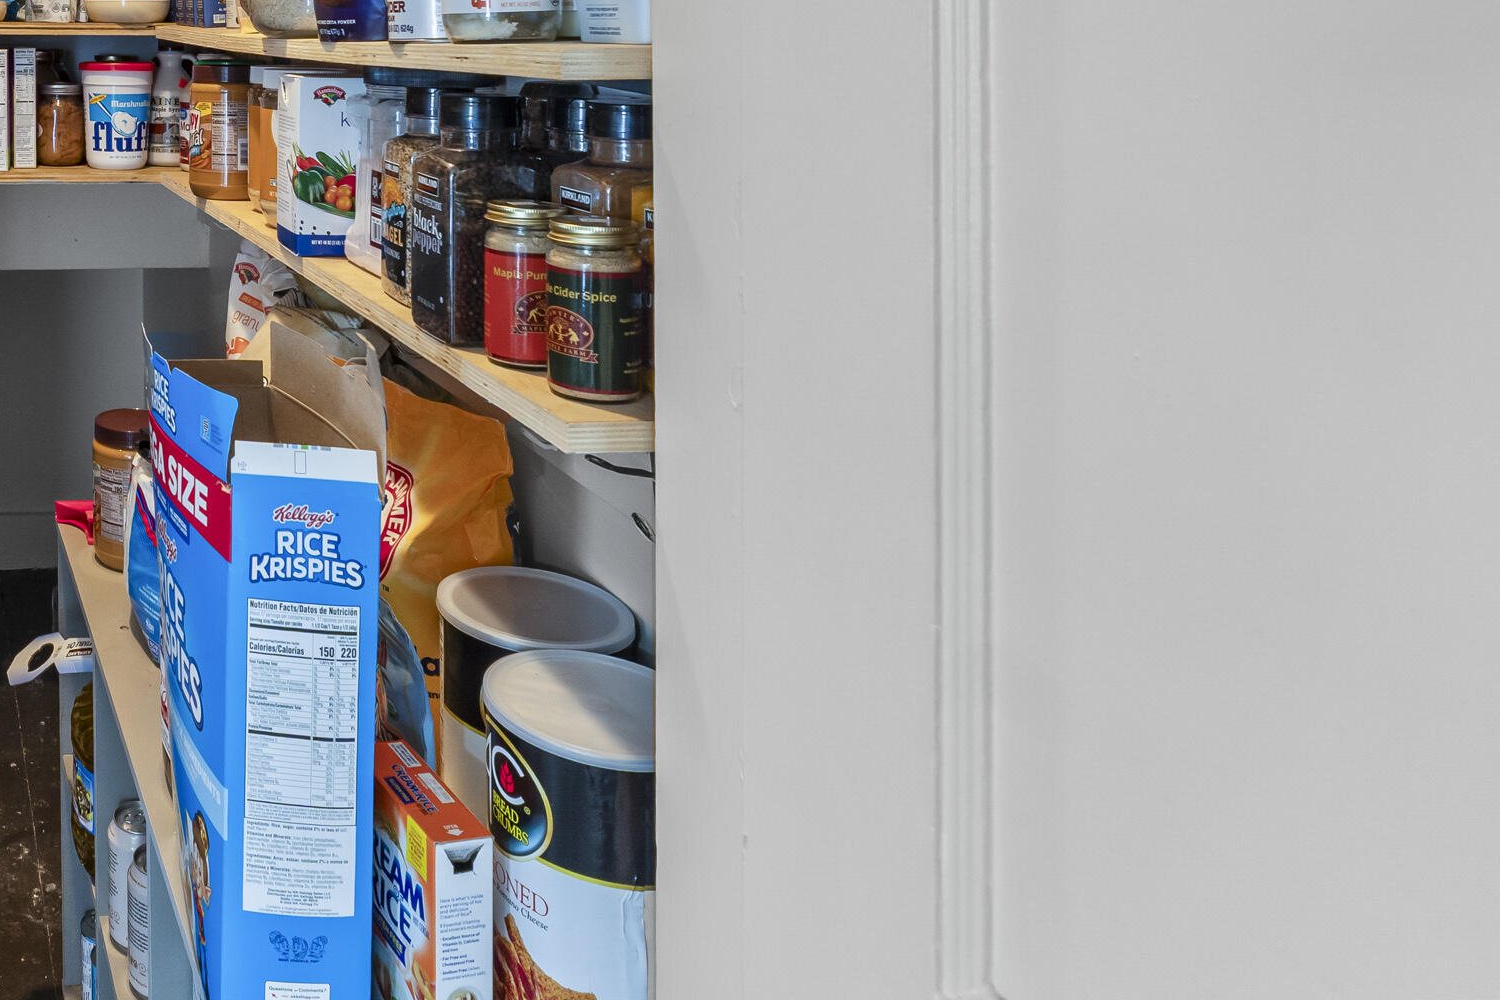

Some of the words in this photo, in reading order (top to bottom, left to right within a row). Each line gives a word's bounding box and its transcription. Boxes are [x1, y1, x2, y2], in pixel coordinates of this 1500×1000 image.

[562, 190, 590, 205] KIRKLAND
[414, 207, 442, 240] black
[412, 228, 442, 255] pepper
[493, 266, 523, 280] Maple
[554, 285, 580, 300] Cider
[584, 291, 618, 304] Spice
[168, 454, 208, 528] SIZE
[274, 504, 334, 528] Kellogg's
[383, 469, 408, 546] HAMMER
[277, 531, 338, 558] RICE
[251, 556, 363, 588] KRISPIES
[250, 600, 278, 610] Nutrition
[280, 602, 318, 614] Facts/Datos
[319, 606, 327, 615] de
[328, 607, 358, 616] Nutrición
[320, 646, 334, 658] 150
[340, 648, 357, 658] 220
[492, 789, 519, 825] BREAD
[492, 806, 530, 846] CRUMBS
[520, 907, 549, 932] Cheese
